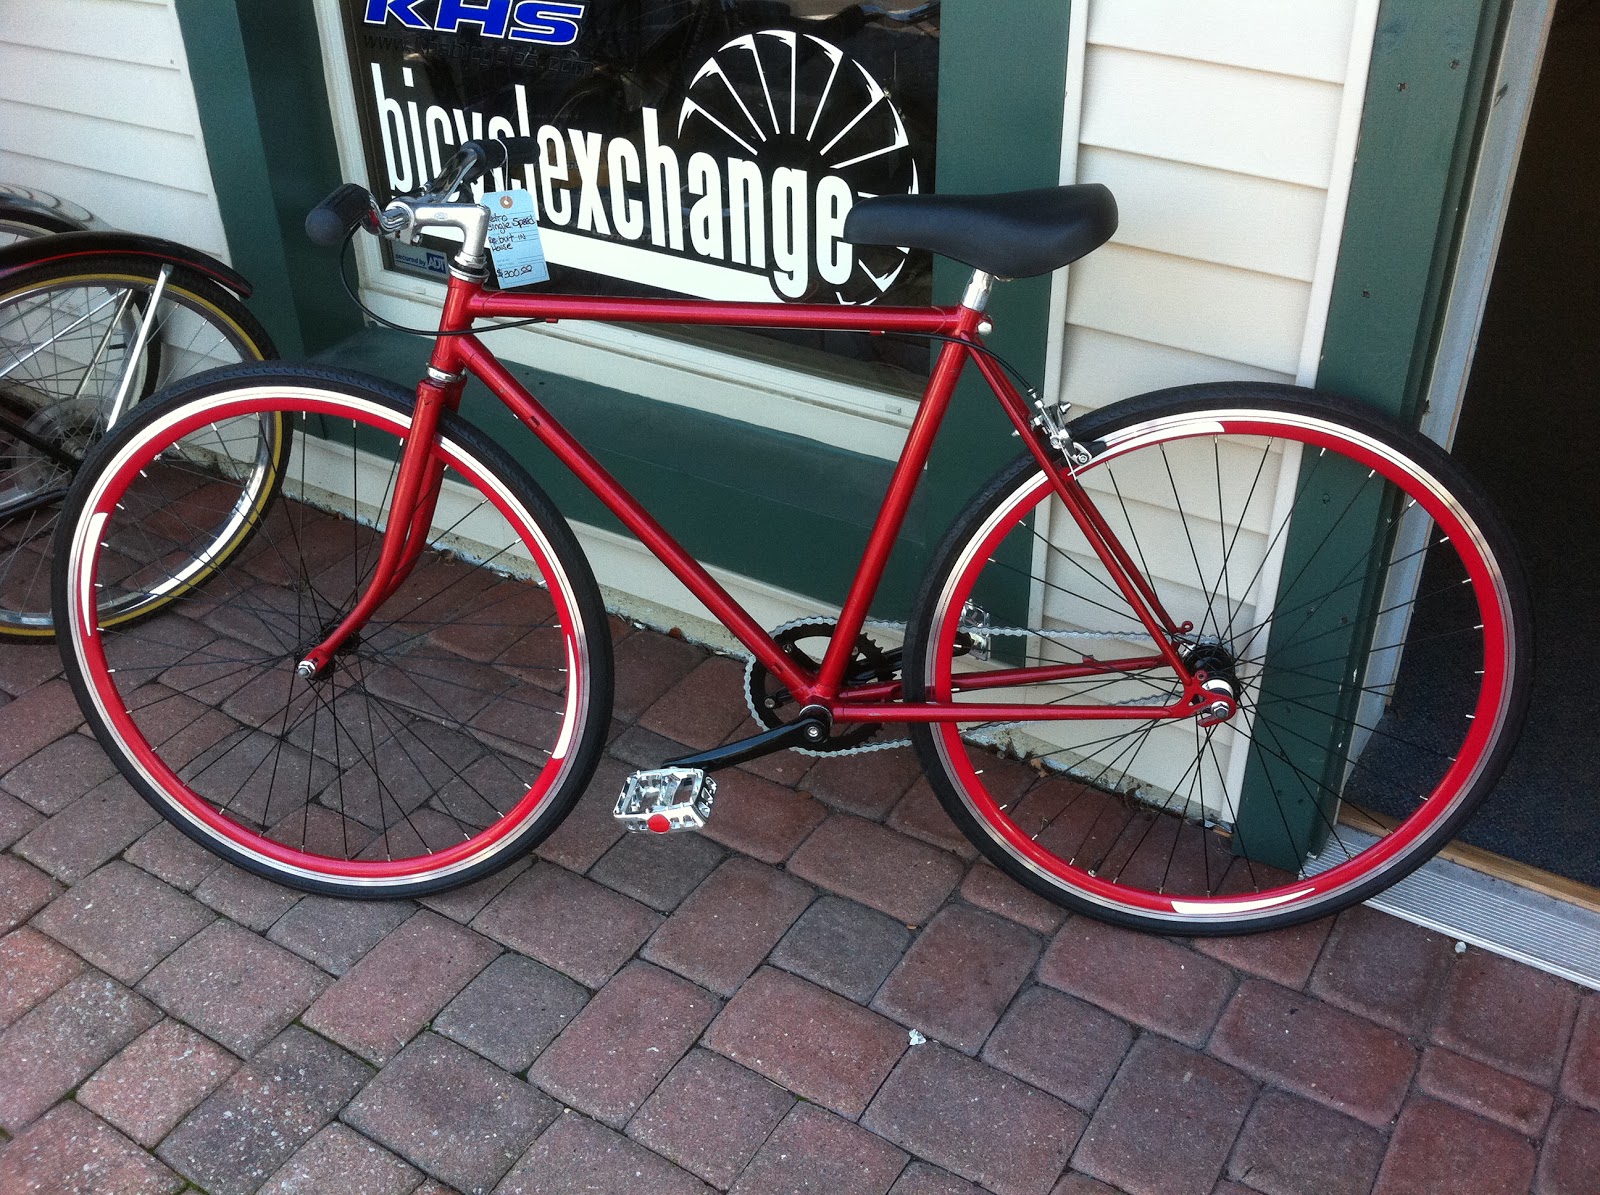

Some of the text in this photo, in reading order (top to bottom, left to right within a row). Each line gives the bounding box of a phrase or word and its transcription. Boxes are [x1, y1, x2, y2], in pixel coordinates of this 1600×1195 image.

[364, 0, 585, 46] KHS
[488, 213, 508, 223] etro
[512, 215, 536, 229] Speed
[395, 253, 446, 272] secured by ADT
